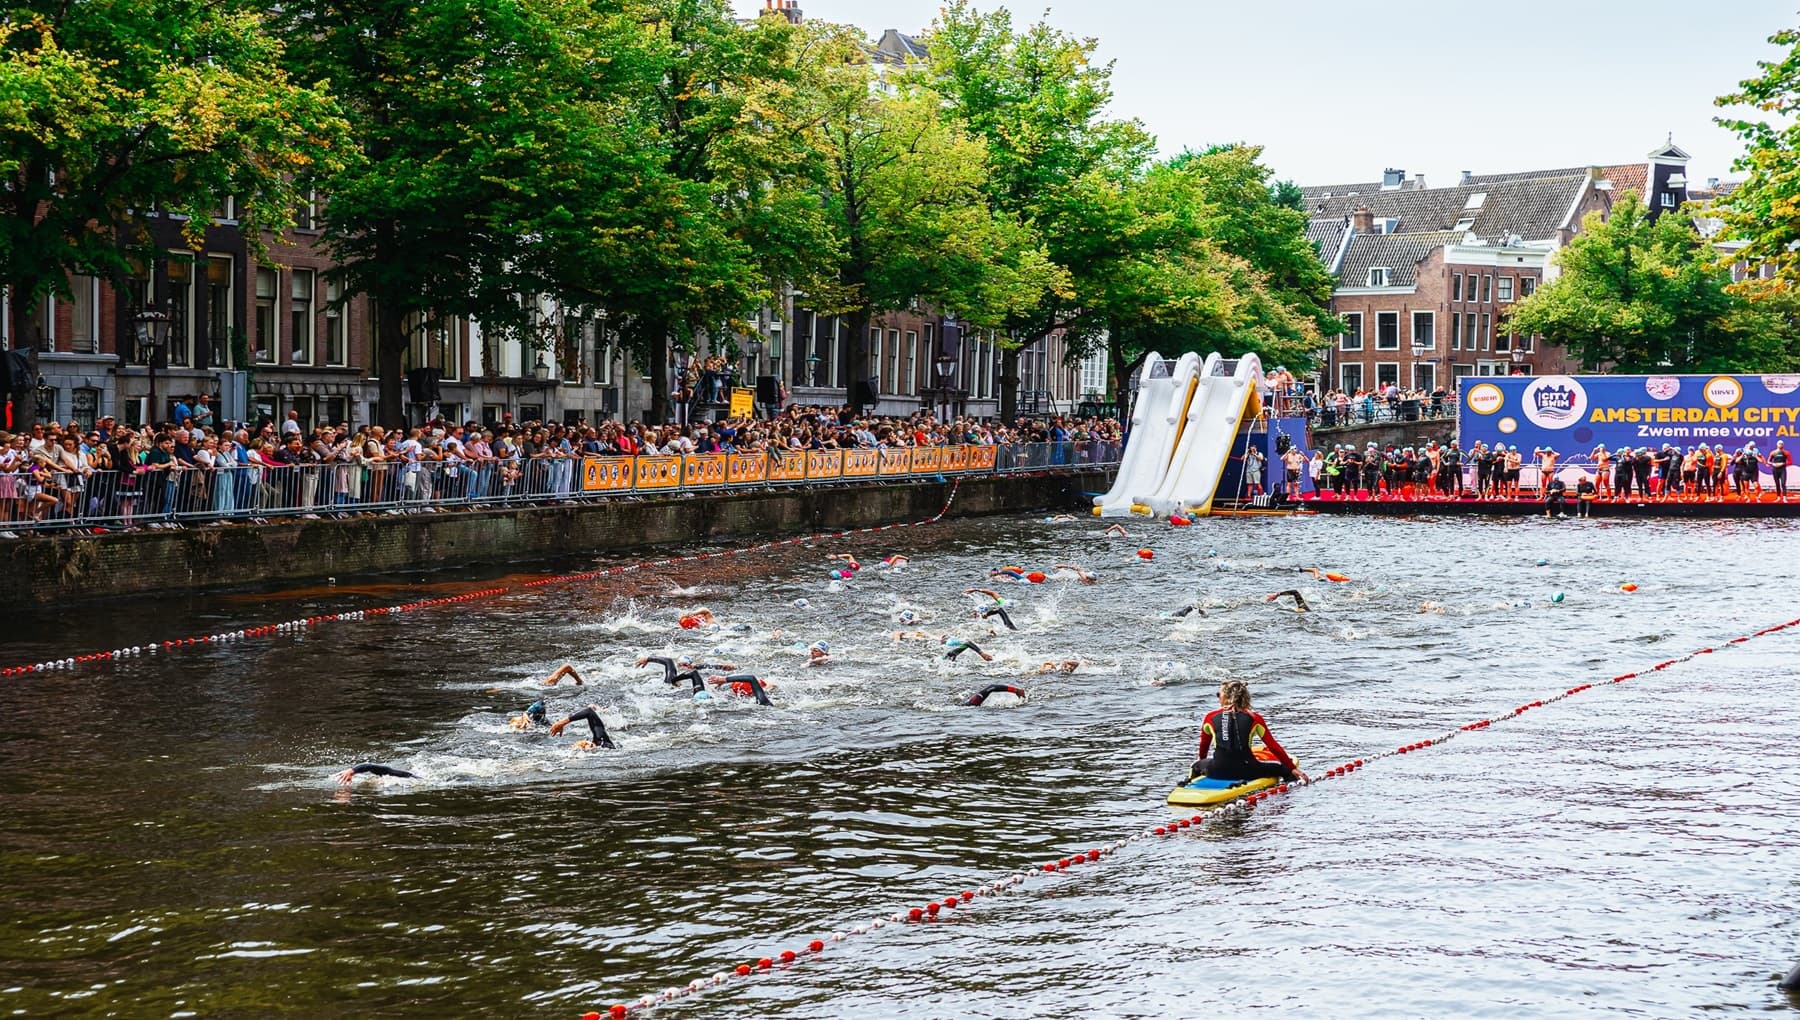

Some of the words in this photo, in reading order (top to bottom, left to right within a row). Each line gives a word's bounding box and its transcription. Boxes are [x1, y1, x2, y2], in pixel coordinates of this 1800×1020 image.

[1542, 392, 1569, 400] CITY
[1589, 407, 1739, 423] AMSTERDAM
[1743, 407, 1800, 423] CITY
[1637, 425, 1689, 437] Zwem
[1693, 426, 1730, 437] mee
[1733, 426, 1774, 437] voor
